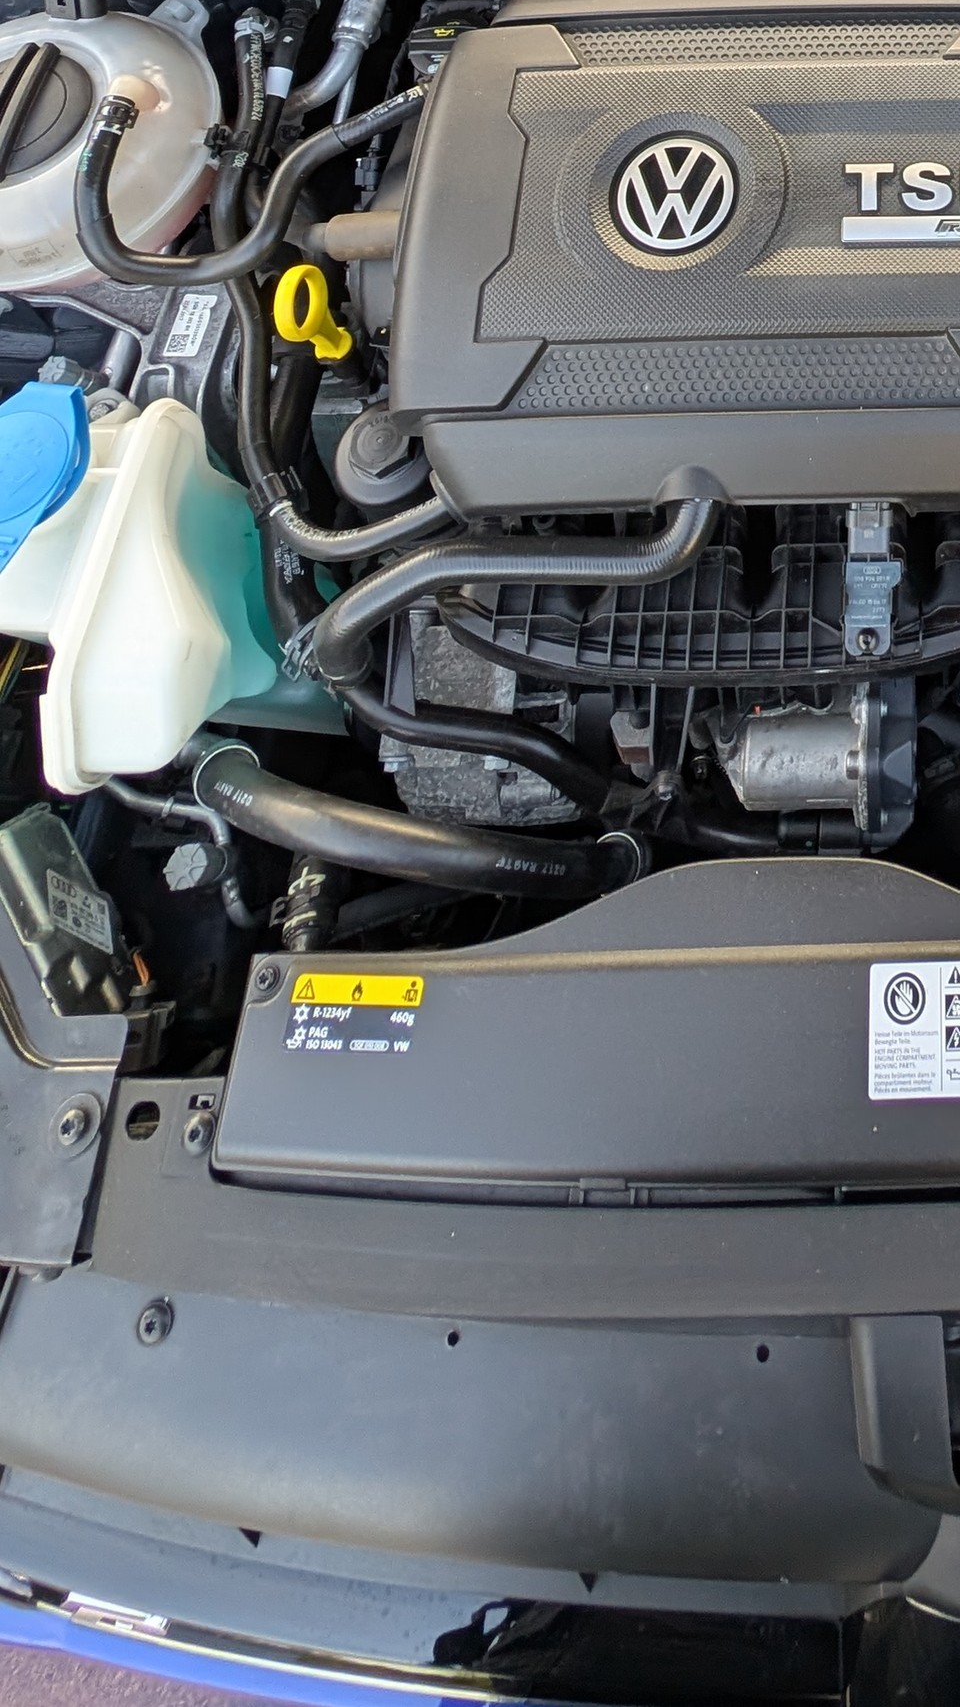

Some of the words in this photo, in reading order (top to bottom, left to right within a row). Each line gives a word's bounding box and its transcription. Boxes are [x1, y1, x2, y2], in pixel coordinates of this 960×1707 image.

[313, 1007, 352, 1022] R-1234yf
[390, 1012, 415, 1027] 460g
[308, 1027, 328, 1038] PAG
[306, 1039, 318, 1050] ISO
[320, 1040, 343, 1050] 13043
[394, 1040, 411, 1052] VW
